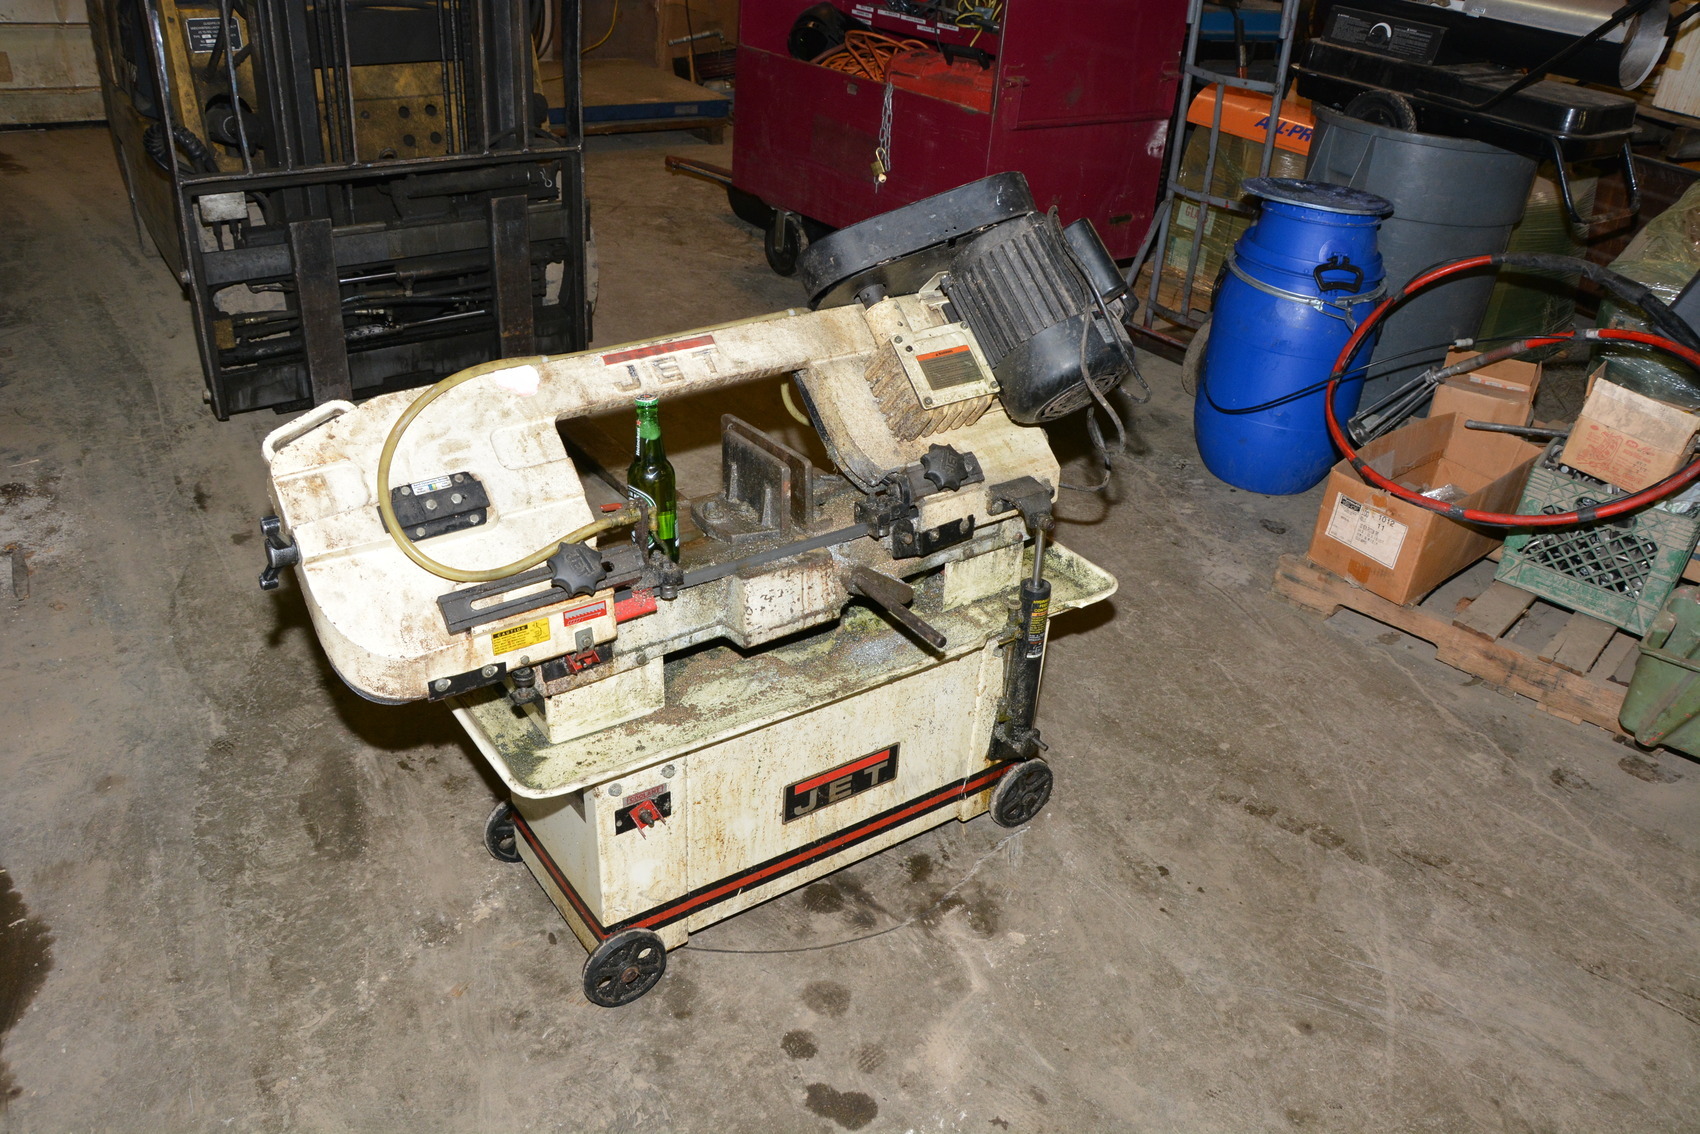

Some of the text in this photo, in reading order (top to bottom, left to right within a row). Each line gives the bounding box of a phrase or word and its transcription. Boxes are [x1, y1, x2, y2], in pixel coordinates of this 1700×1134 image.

[1254, 116, 1313, 141] AL-PR
[613, 347, 720, 392] JET
[497, 625, 527, 638] CAUTION
[793, 760, 889, 816] JET
